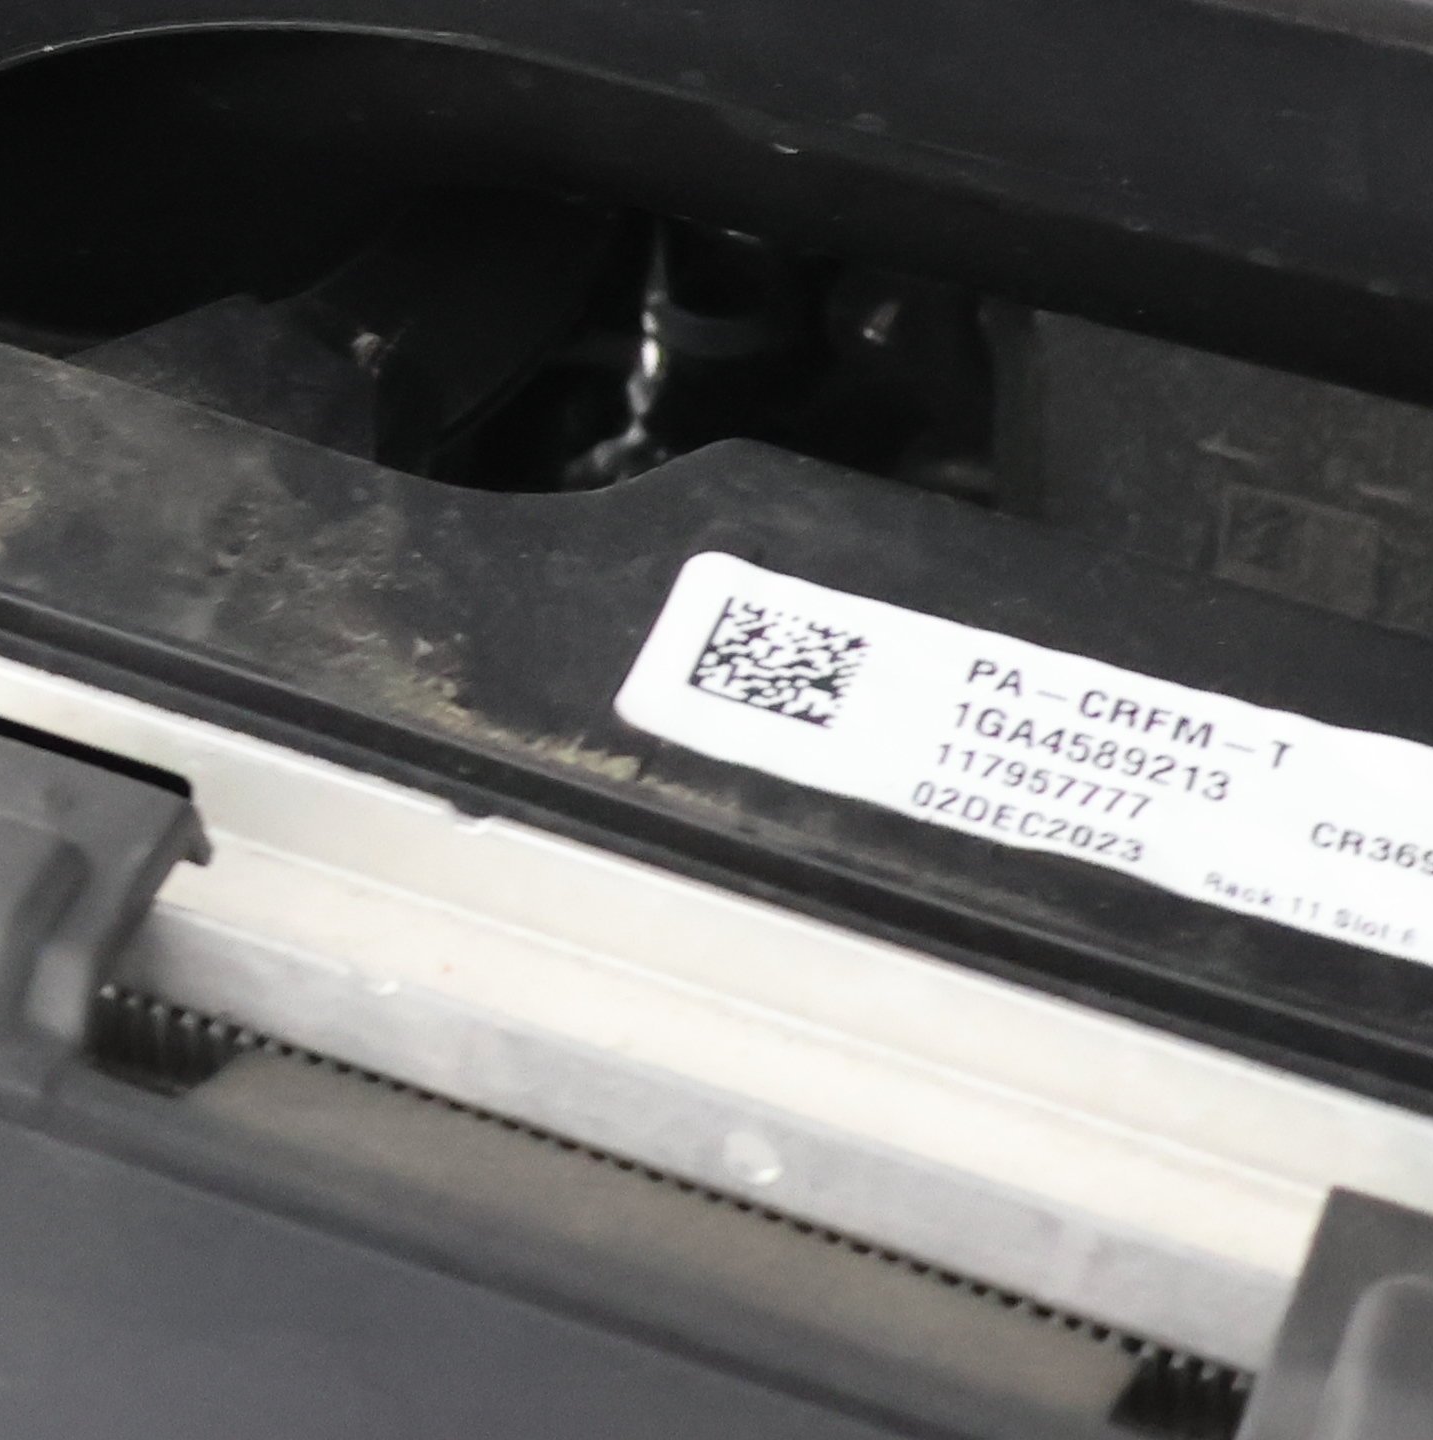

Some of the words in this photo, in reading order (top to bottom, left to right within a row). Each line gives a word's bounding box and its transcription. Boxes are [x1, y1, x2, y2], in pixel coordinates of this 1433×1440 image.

[938, 743, 1151, 819] 117957777
[955, 702, 1232, 802] 1GA4589213
[912, 780, 1145, 863] 02DEC2023
